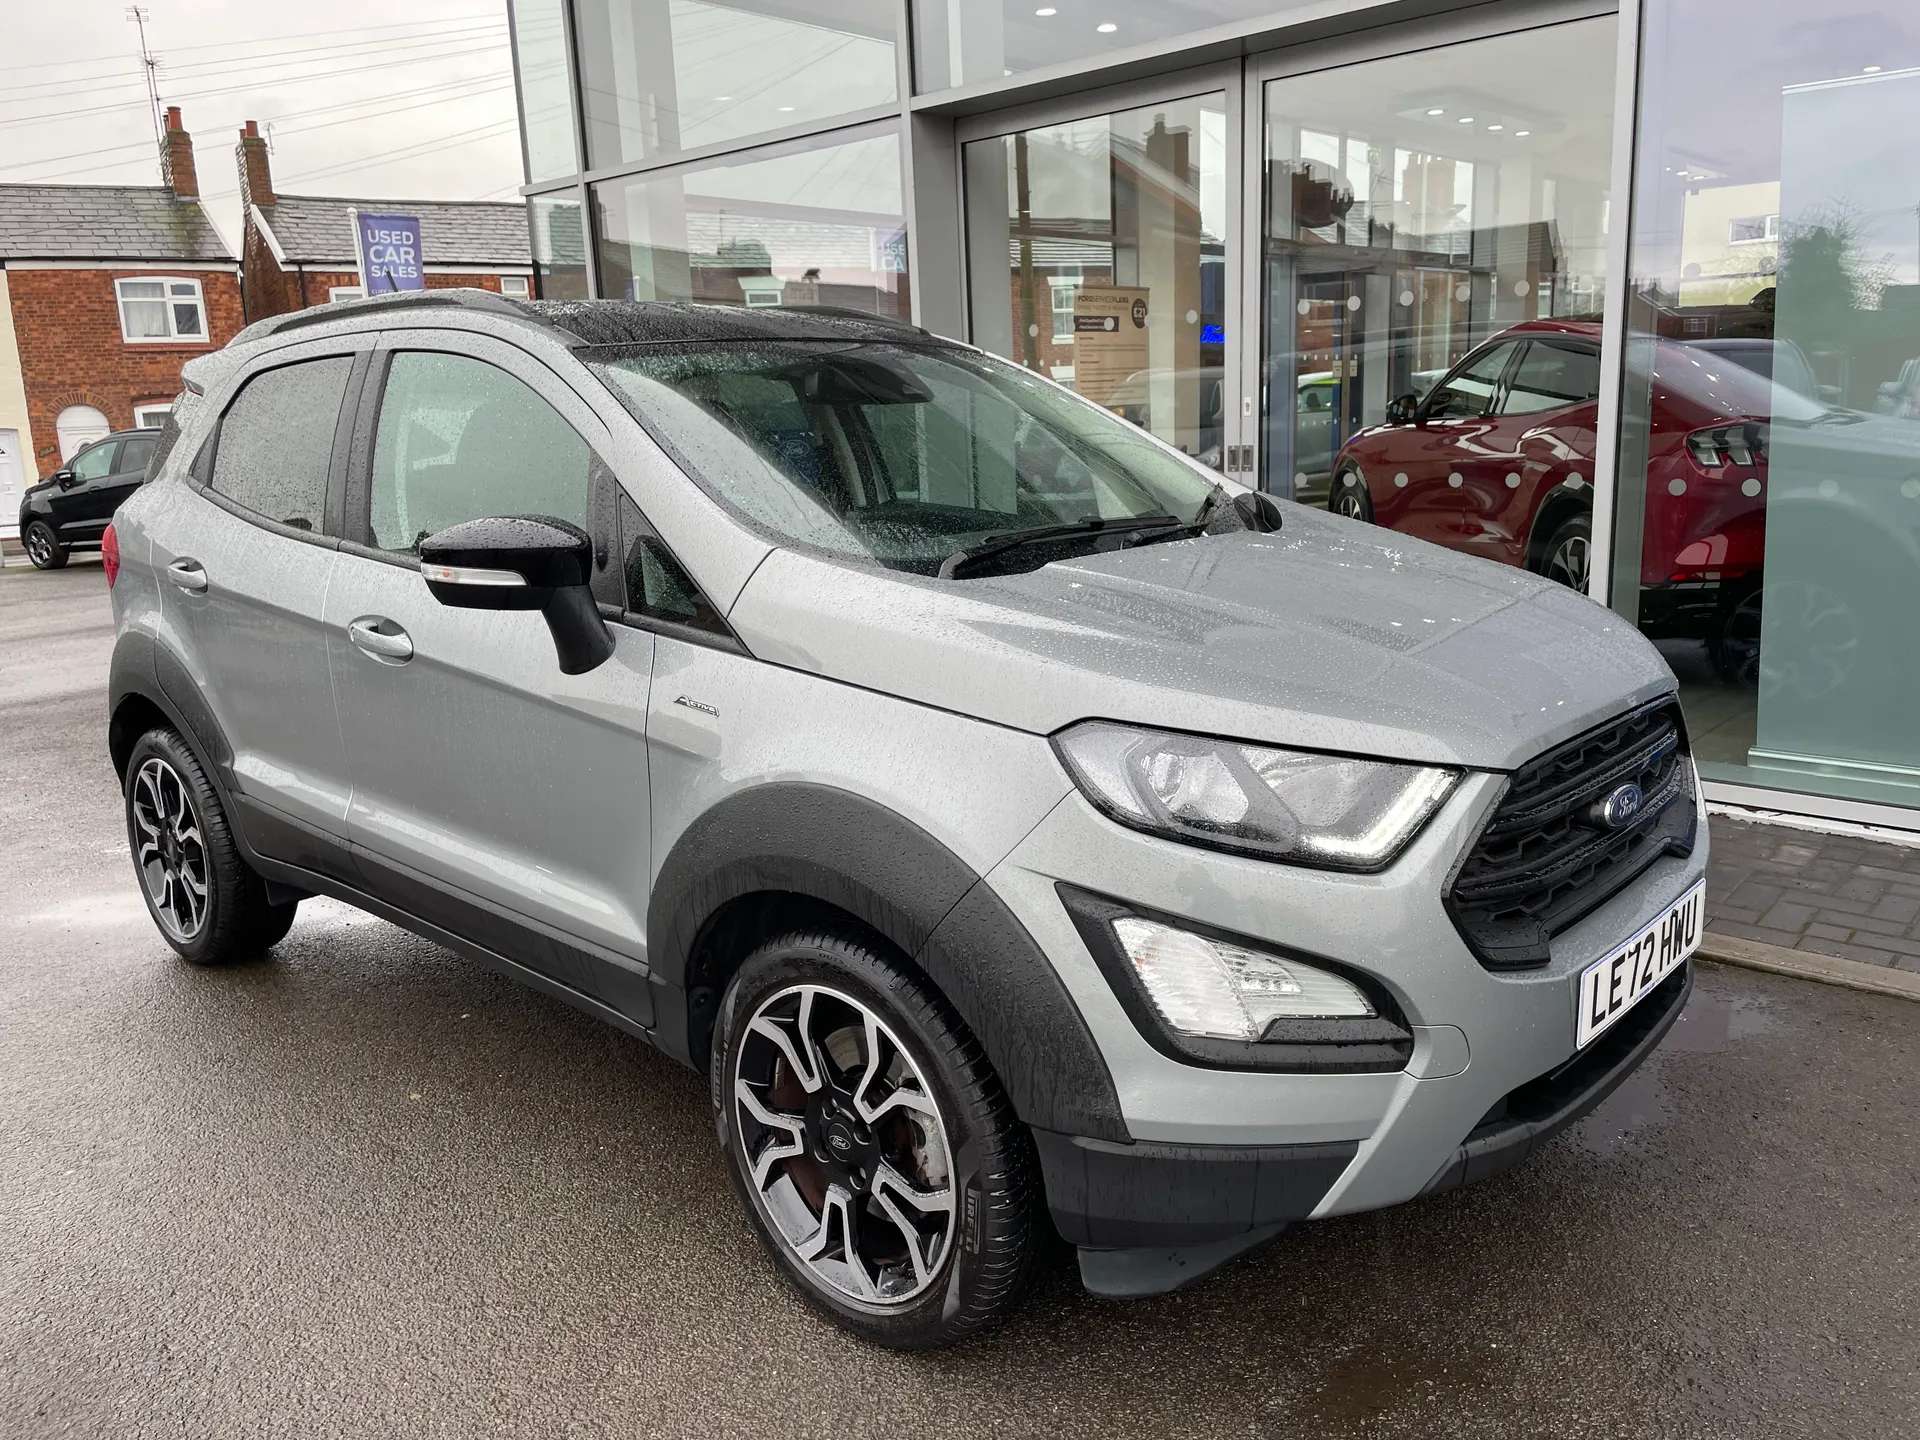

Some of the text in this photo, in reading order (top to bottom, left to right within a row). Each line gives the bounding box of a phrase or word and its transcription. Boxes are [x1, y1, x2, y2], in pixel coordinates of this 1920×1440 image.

[367, 229, 414, 245] USED
[369, 245, 415, 264] CAR
[371, 265, 418, 278] SALES
[1617, 792, 1639, 819] Ford
[1591, 931, 1655, 1029] LE72
[831, 1136, 848, 1148] Ford
